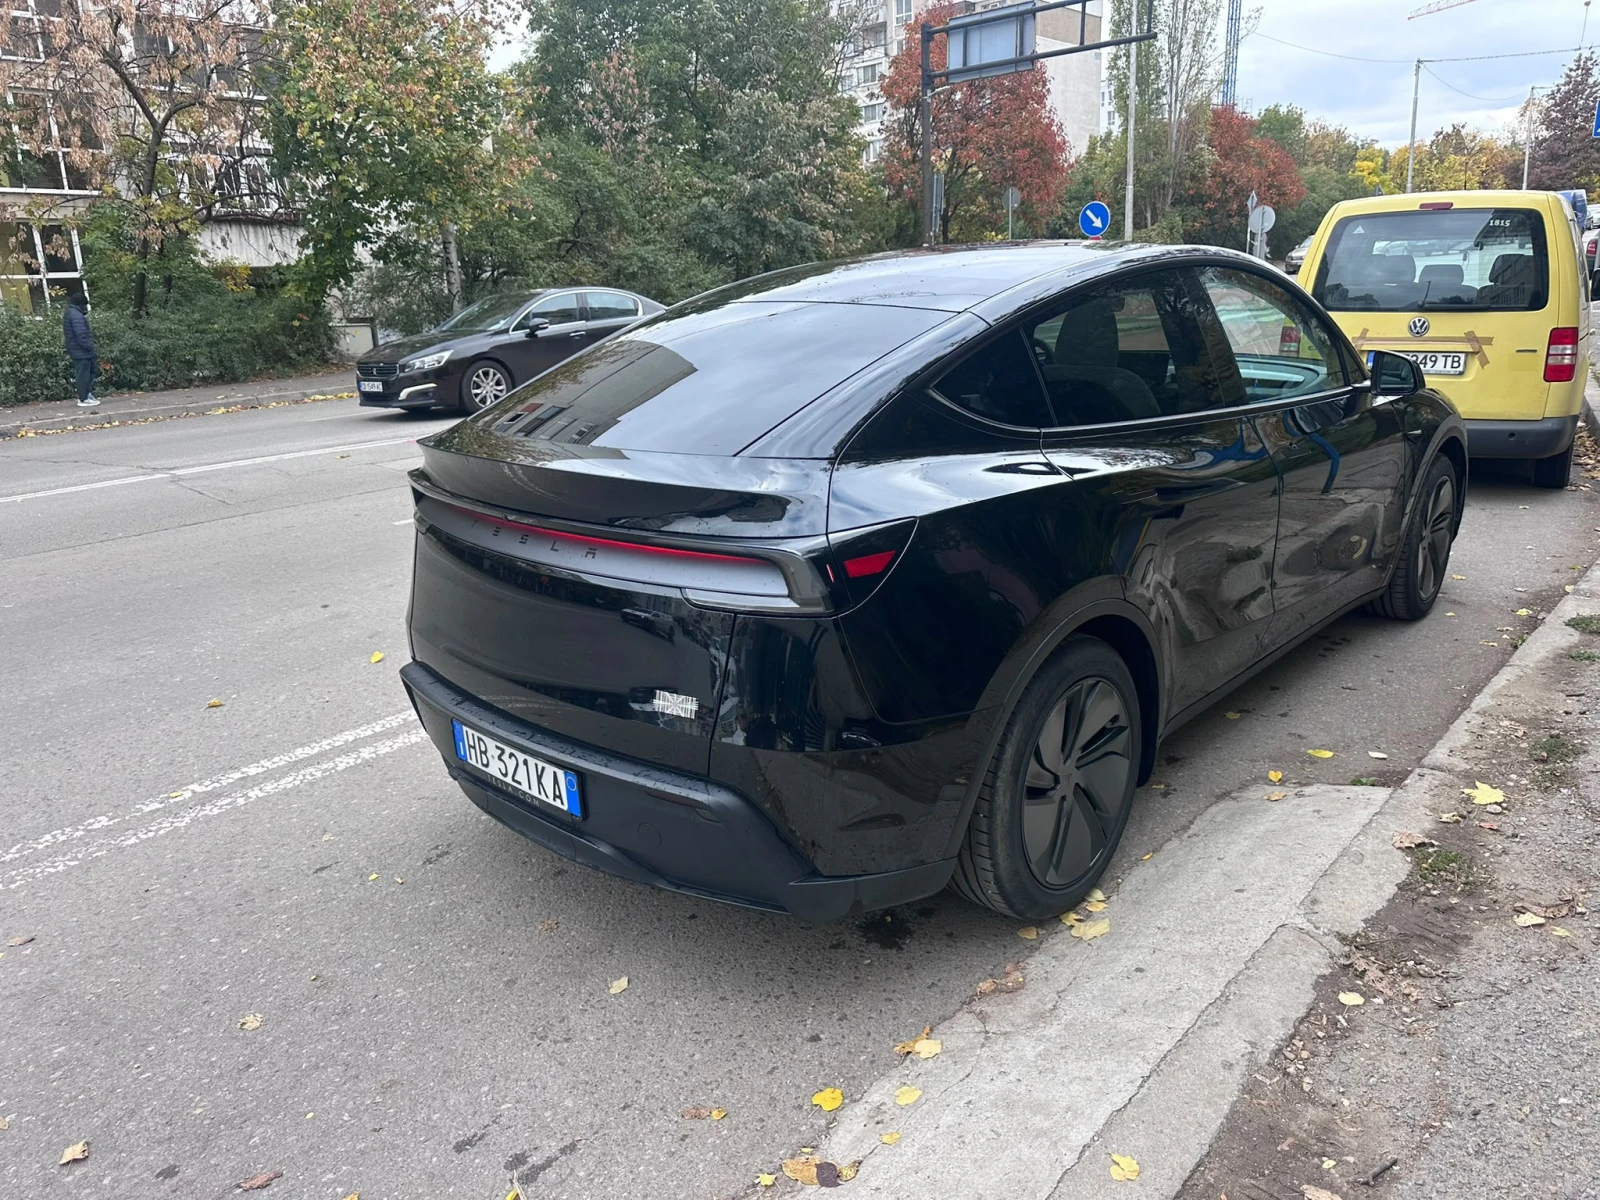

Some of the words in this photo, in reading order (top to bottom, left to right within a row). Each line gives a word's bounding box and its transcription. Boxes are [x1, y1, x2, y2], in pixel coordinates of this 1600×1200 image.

[1489, 219, 1511, 227] 1815
[1405, 353, 1438, 369] 49
[1441, 354, 1461, 369] TB
[470, 518, 597, 559] TESLA
[465, 729, 490, 769] HB
[494, 744, 565, 806] 321KA
